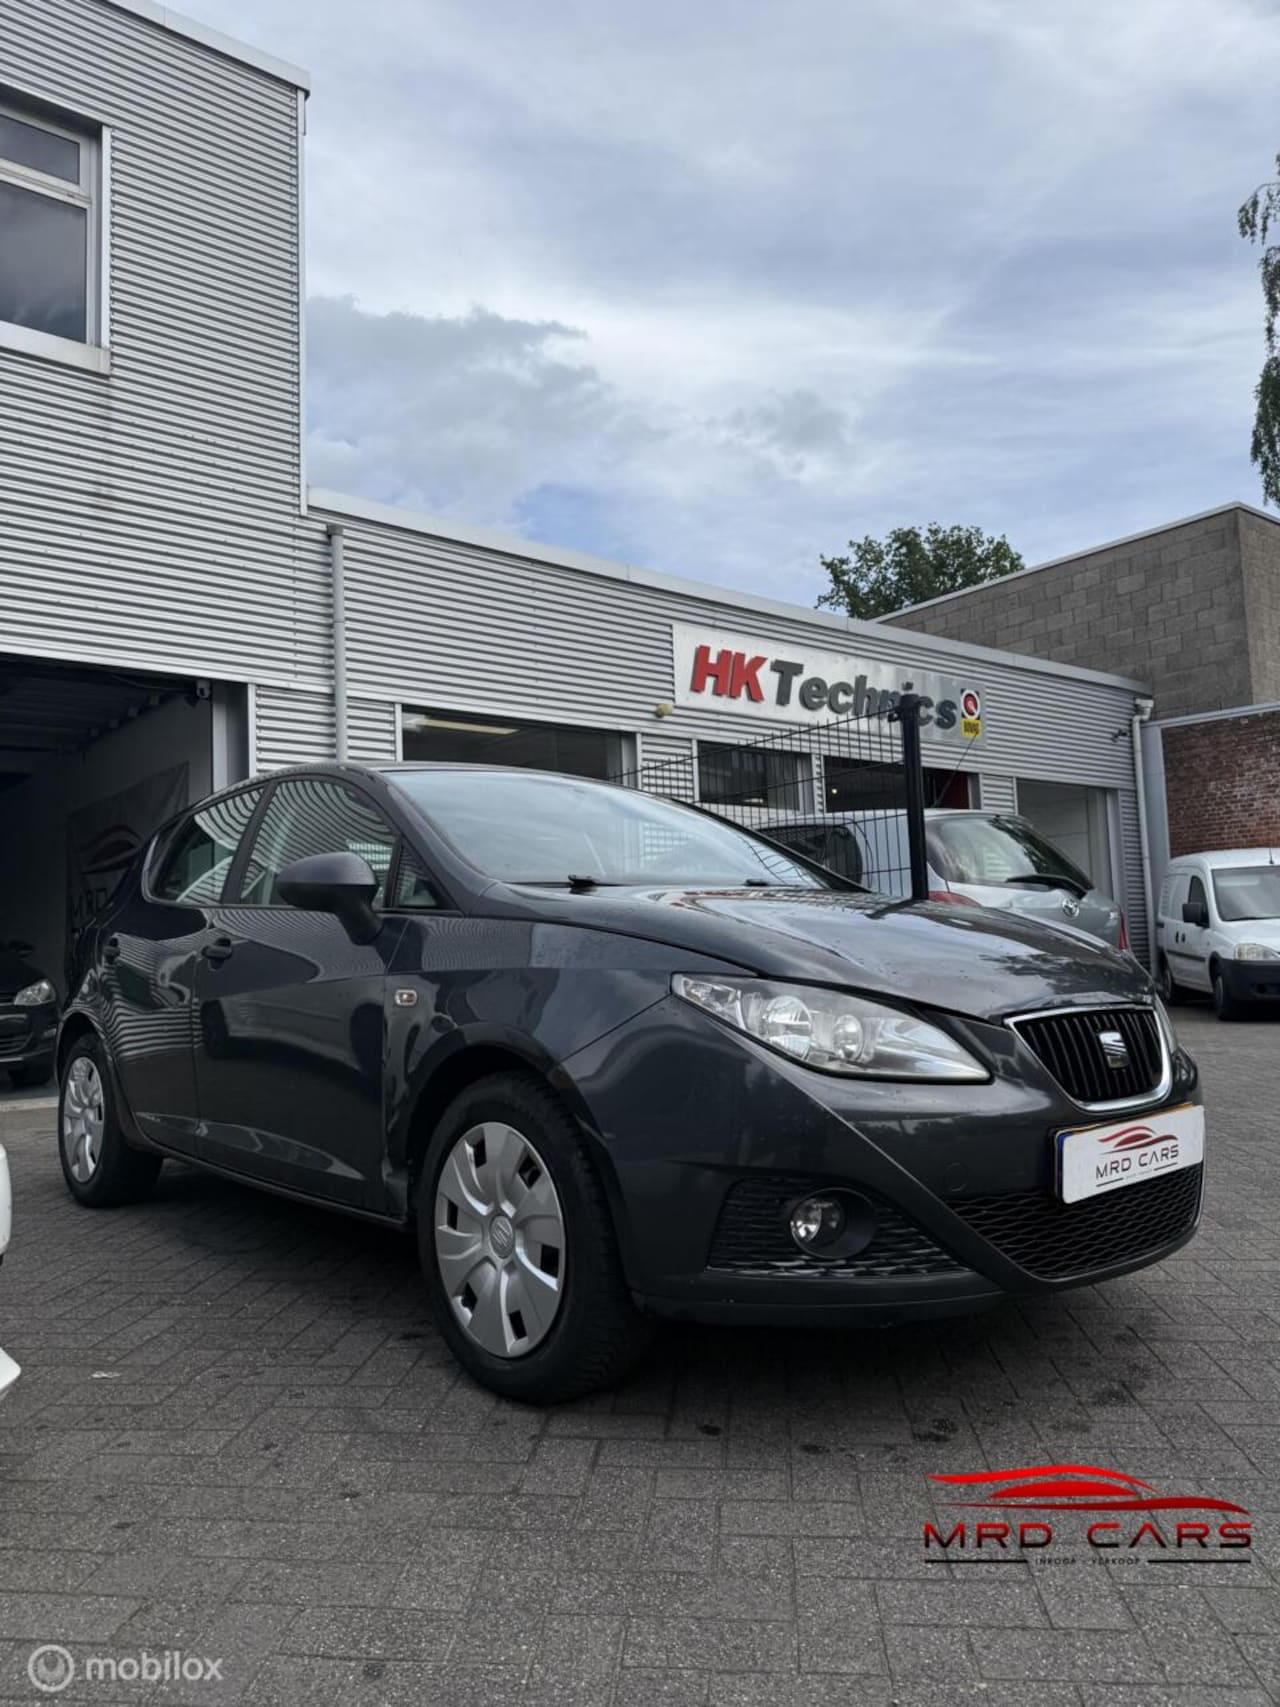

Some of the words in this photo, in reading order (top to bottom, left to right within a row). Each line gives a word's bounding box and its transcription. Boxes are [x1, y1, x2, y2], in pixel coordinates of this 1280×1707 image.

[770, 659, 957, 729] Techncs
[1095, 1157, 1132, 1179] MRD
[1138, 1144, 1180, 1167] CARS
